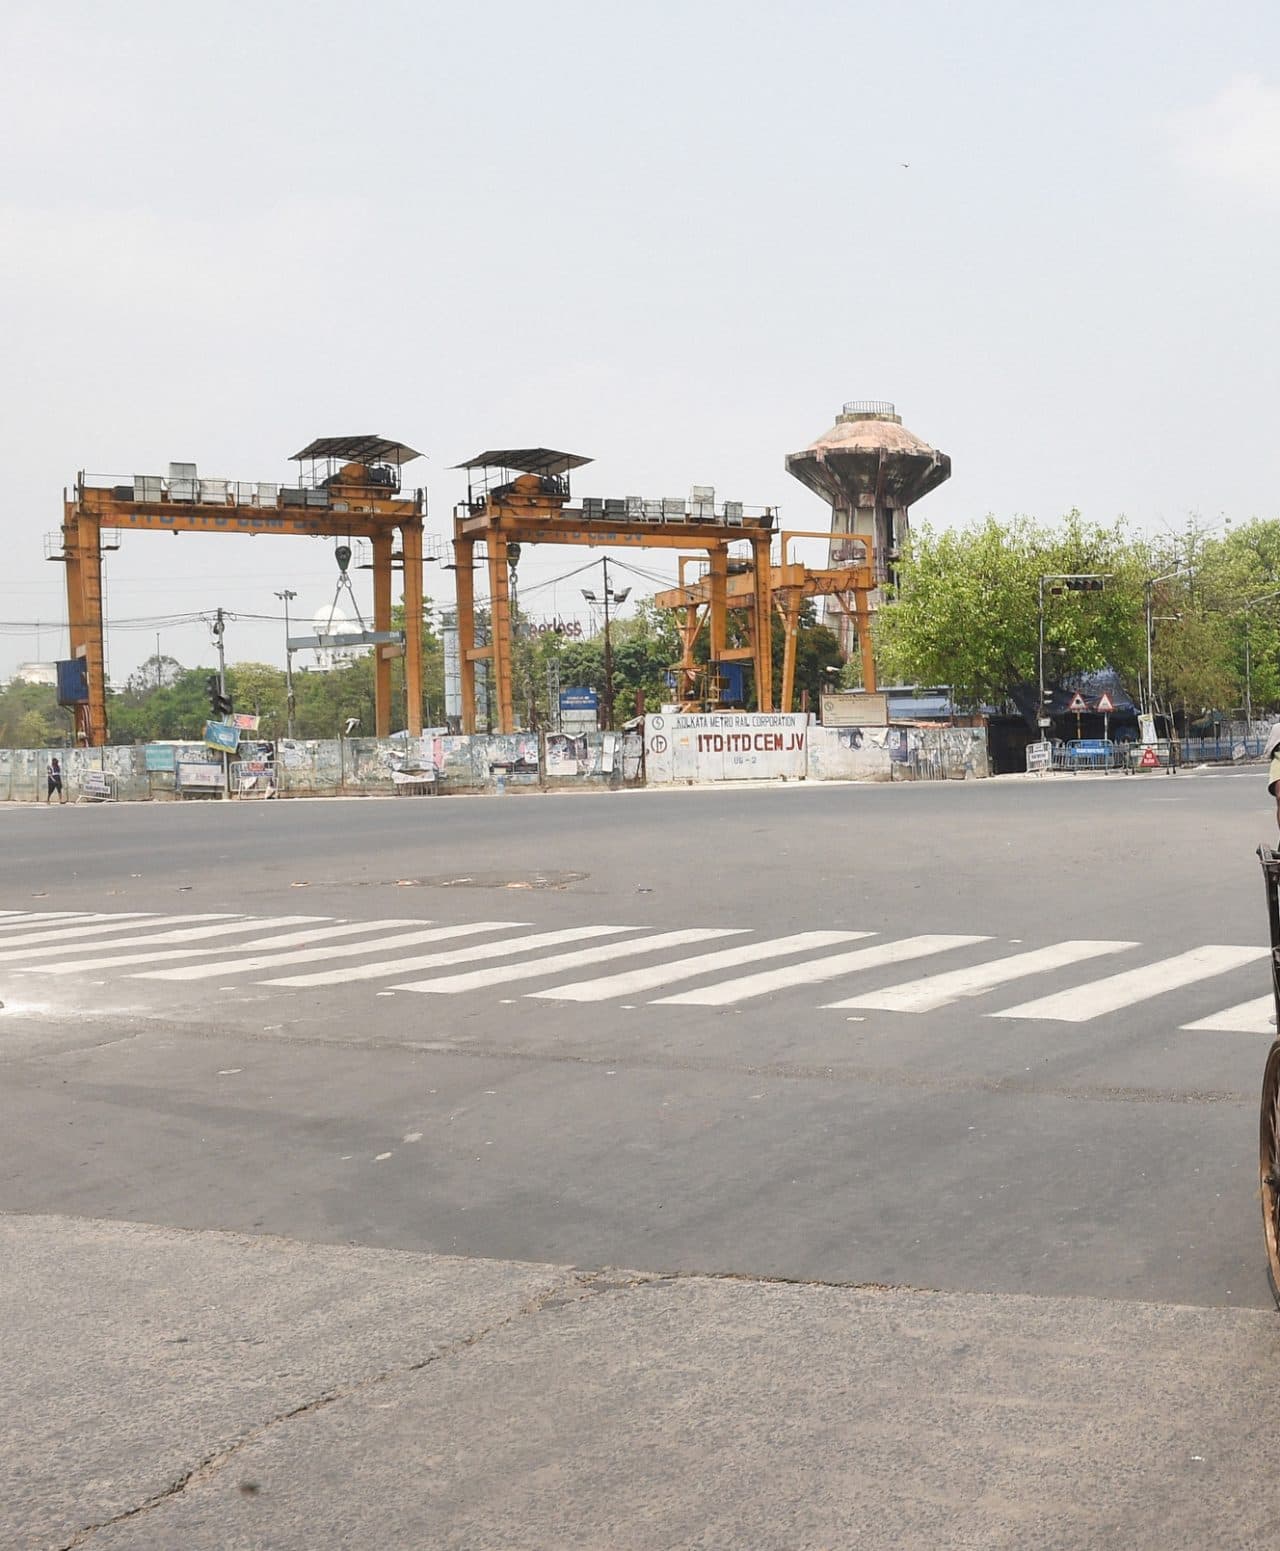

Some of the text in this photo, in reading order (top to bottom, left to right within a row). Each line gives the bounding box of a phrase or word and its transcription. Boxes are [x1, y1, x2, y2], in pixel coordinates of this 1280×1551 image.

[529, 617, 583, 638] eerless
[676, 716, 796, 728] KOLKATA METRO RAIL CORPORATION
[754, 733, 783, 751] CEM
[786, 733, 804, 751] JV
